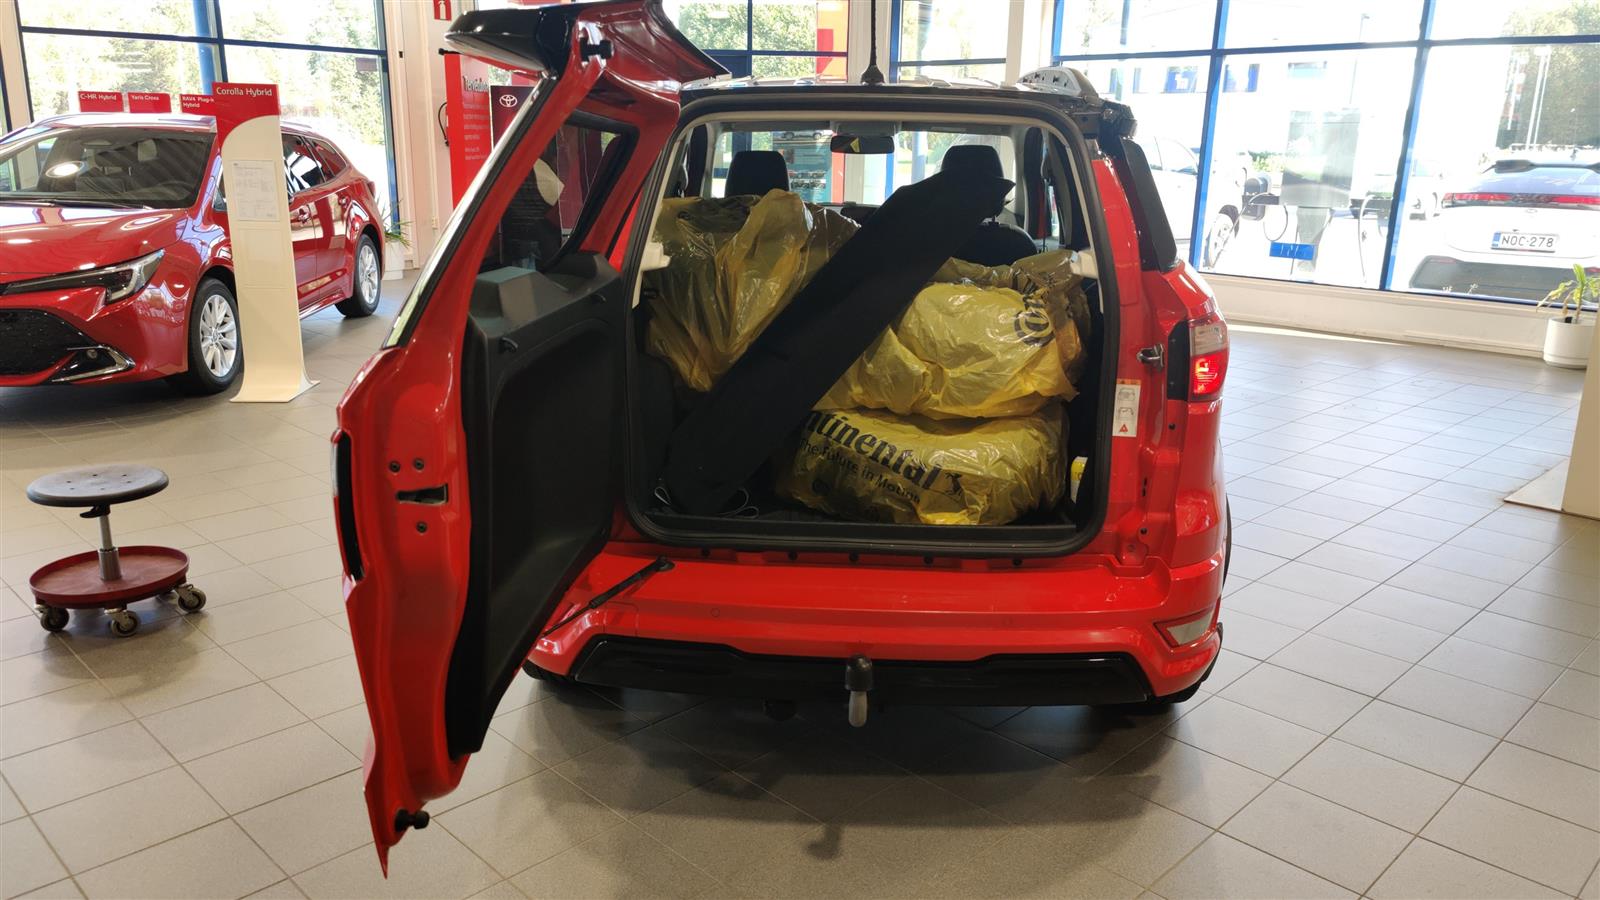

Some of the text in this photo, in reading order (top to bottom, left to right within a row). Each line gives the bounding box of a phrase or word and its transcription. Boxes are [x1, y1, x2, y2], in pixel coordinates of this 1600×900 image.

[216, 87, 273, 98] Corolla Hybrid
[1501, 235, 1554, 248] NOC-278
